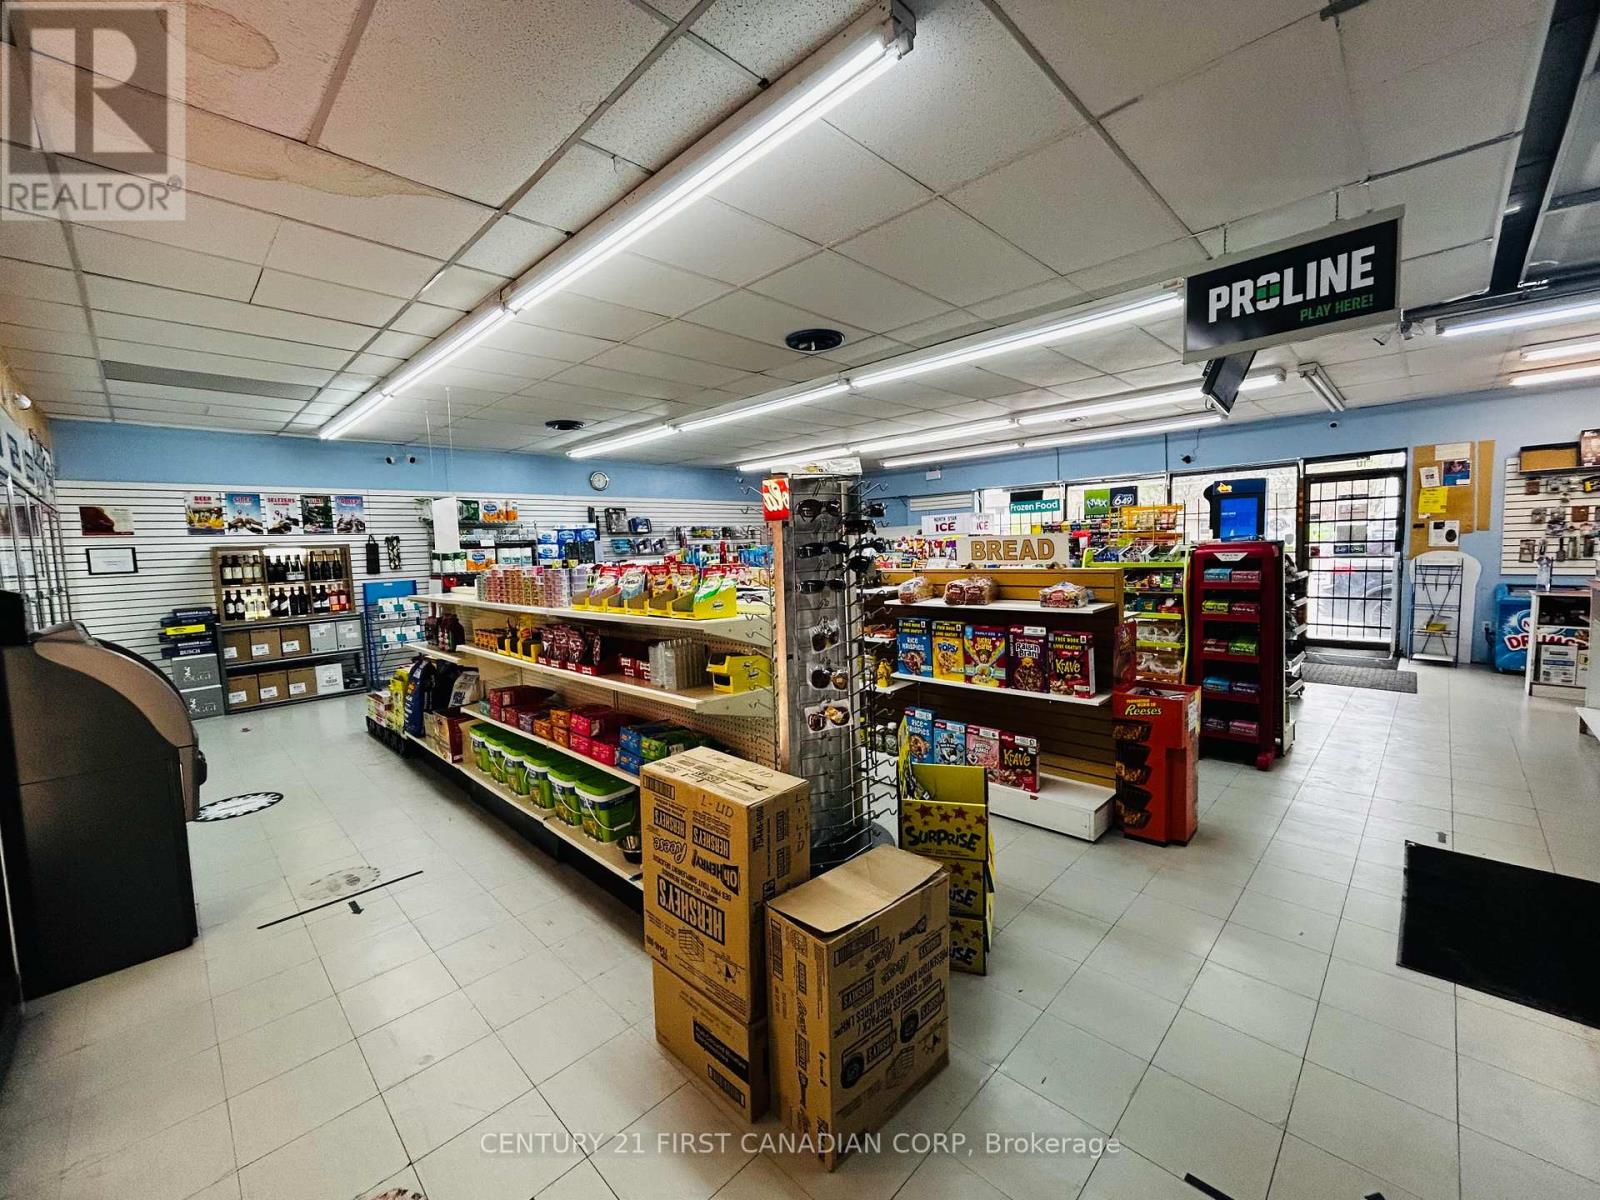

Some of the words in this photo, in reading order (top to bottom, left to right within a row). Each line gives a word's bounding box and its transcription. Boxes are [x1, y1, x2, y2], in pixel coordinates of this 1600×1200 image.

[1208, 245, 1375, 323] PROLINE
[1300, 302, 1332, 322] PLAY
[1335, 293, 1374, 315] HERE!
[1010, 503, 1034, 512] Frozen
[1035, 500, 1057, 510] Food
[935, 522, 956, 532] ICE
[970, 538, 1055, 561] BREAD
[1015, 642, 1040, 654] Raisin
[1017, 649, 1039, 659] Bran
[655, 808, 685, 838] HERSHEY'S
[693, 826, 728, 859] HERSHEY'S
[723, 868, 738, 888] Oh
[659, 878, 723, 942] HERSHEY'S
